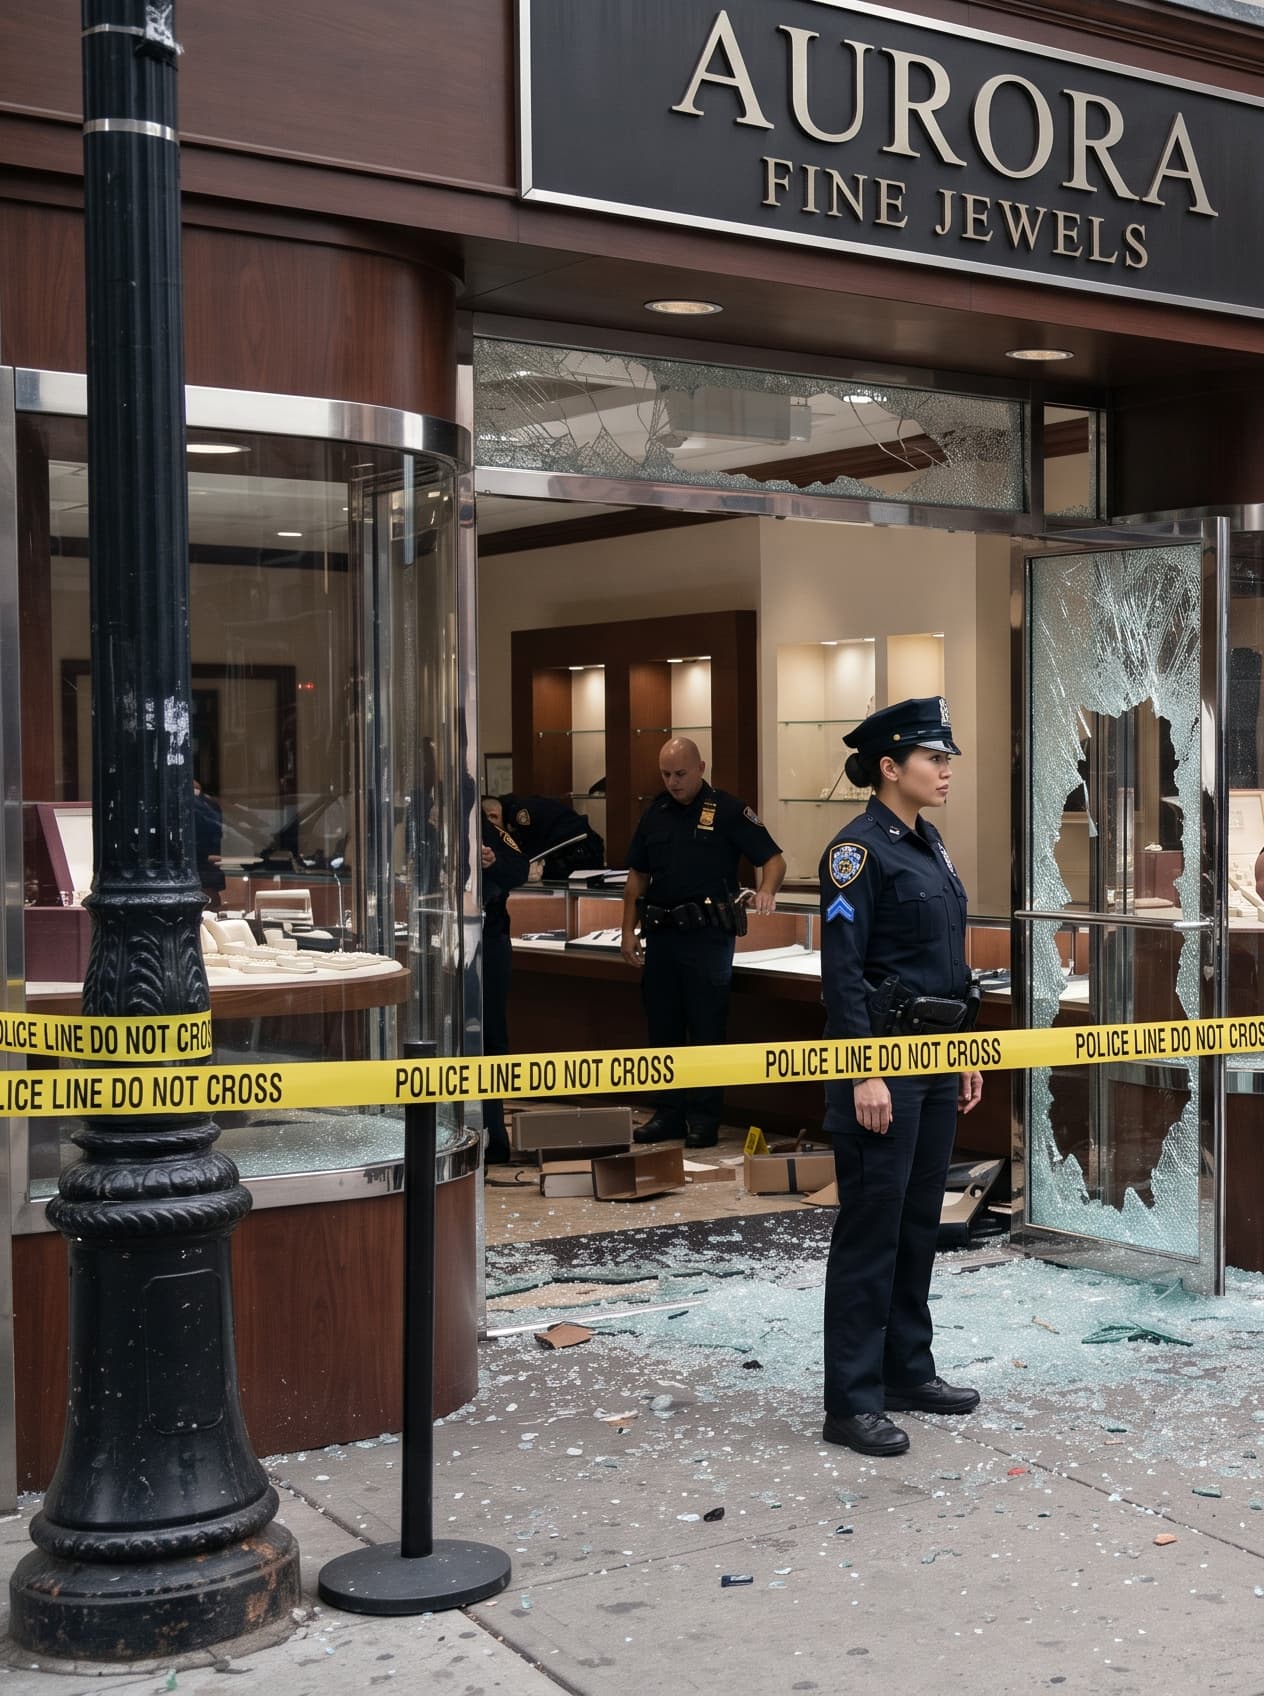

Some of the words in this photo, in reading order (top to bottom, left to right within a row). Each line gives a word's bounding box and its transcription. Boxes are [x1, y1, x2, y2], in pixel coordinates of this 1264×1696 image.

[671, 9, 1219, 217] AURORA
[761, 155, 908, 229] FINE
[935, 188, 1148, 269] JEWELS
[44, 1024, 83, 1054] LINE
[91, 1025, 118, 1054] DO
[126, 1024, 169, 1054] NOT
[766, 1048, 828, 1078] POLICE
[835, 1045, 872, 1075] LINE
[878, 1043, 901, 1072] DO
[908, 1041, 941, 1070] NOT
[947, 1037, 1001, 1067] CROSS
[1075, 1030, 1129, 1058] POLICE
[1135, 1028, 1166, 1055] LINE
[1171, 1026, 1191, 1052] DO
[1196, 1024, 1224, 1050] NOT
[52, 1078, 102, 1110] LINE
[112, 1076, 143, 1109] DO
[153, 1075, 199, 1108] NOT
[207, 1073, 283, 1105] CROSS
[395, 1065, 469, 1098] POLICE
[478, 1062, 522, 1094] LINE
[529, 1061, 556, 1091] DO
[564, 1058, 603, 1089] NOT
[610, 1055, 674, 1086] CROSS
